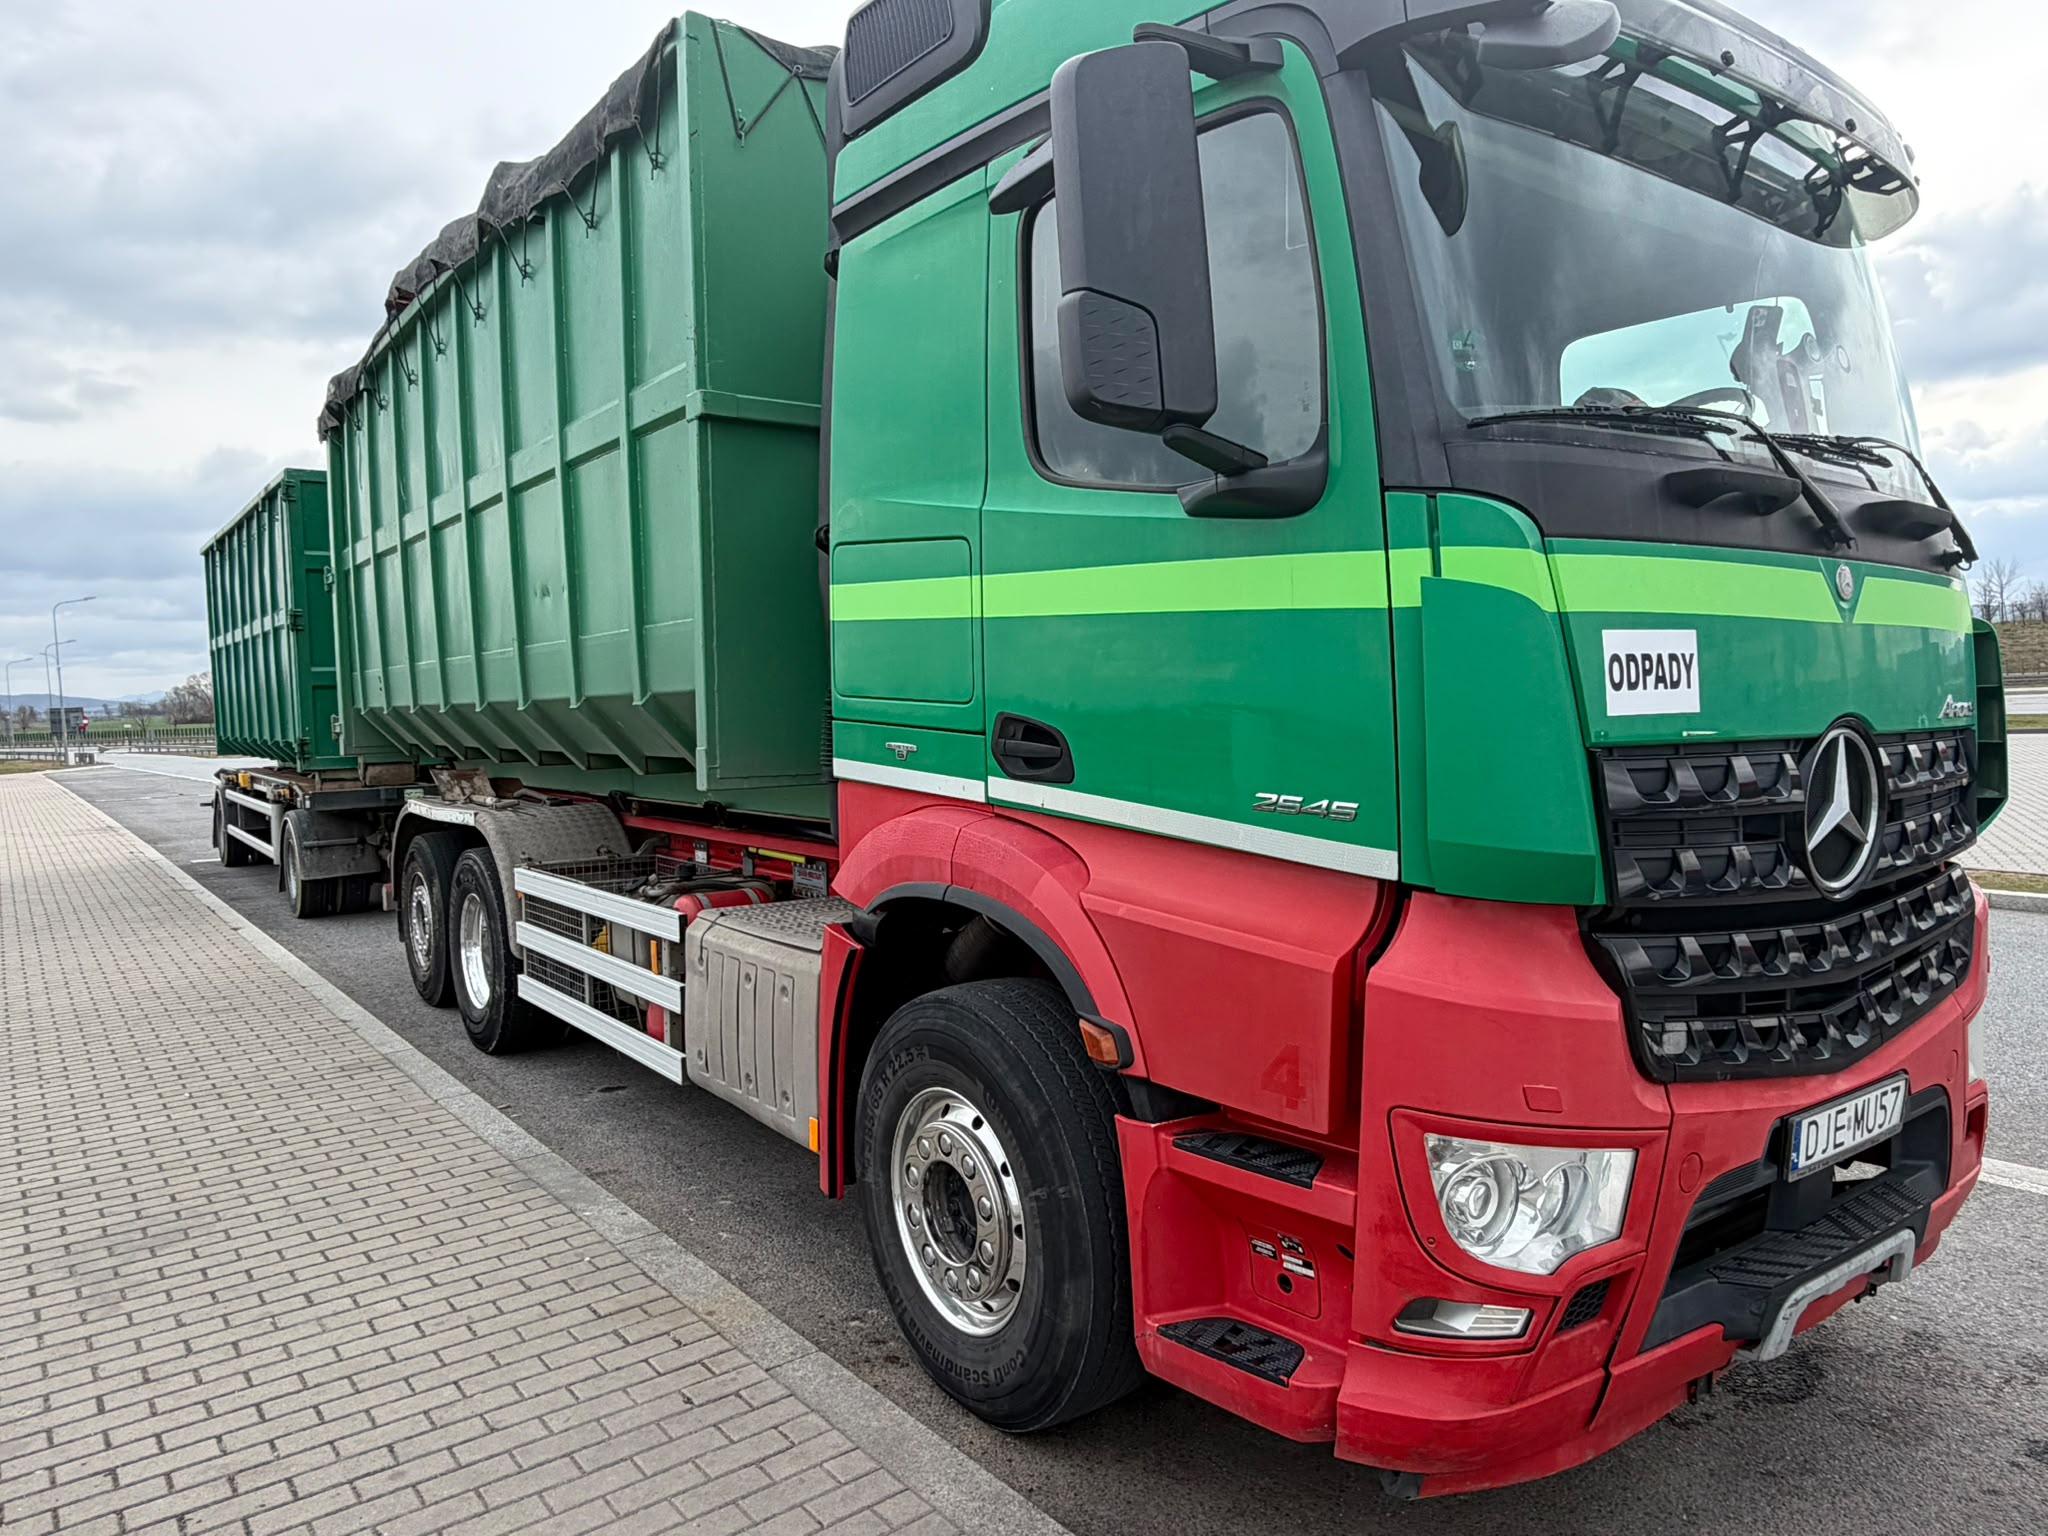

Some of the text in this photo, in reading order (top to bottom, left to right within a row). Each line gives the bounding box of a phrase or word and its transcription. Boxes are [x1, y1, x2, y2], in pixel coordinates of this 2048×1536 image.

[1608, 652, 1695, 692] ODPADY
[1252, 792, 1359, 822] 2545
[888, 1050, 915, 1077] 22.5
[1260, 1043, 1307, 1111] 4
[907, 1316, 1027, 1389] Conti Scandinavia
